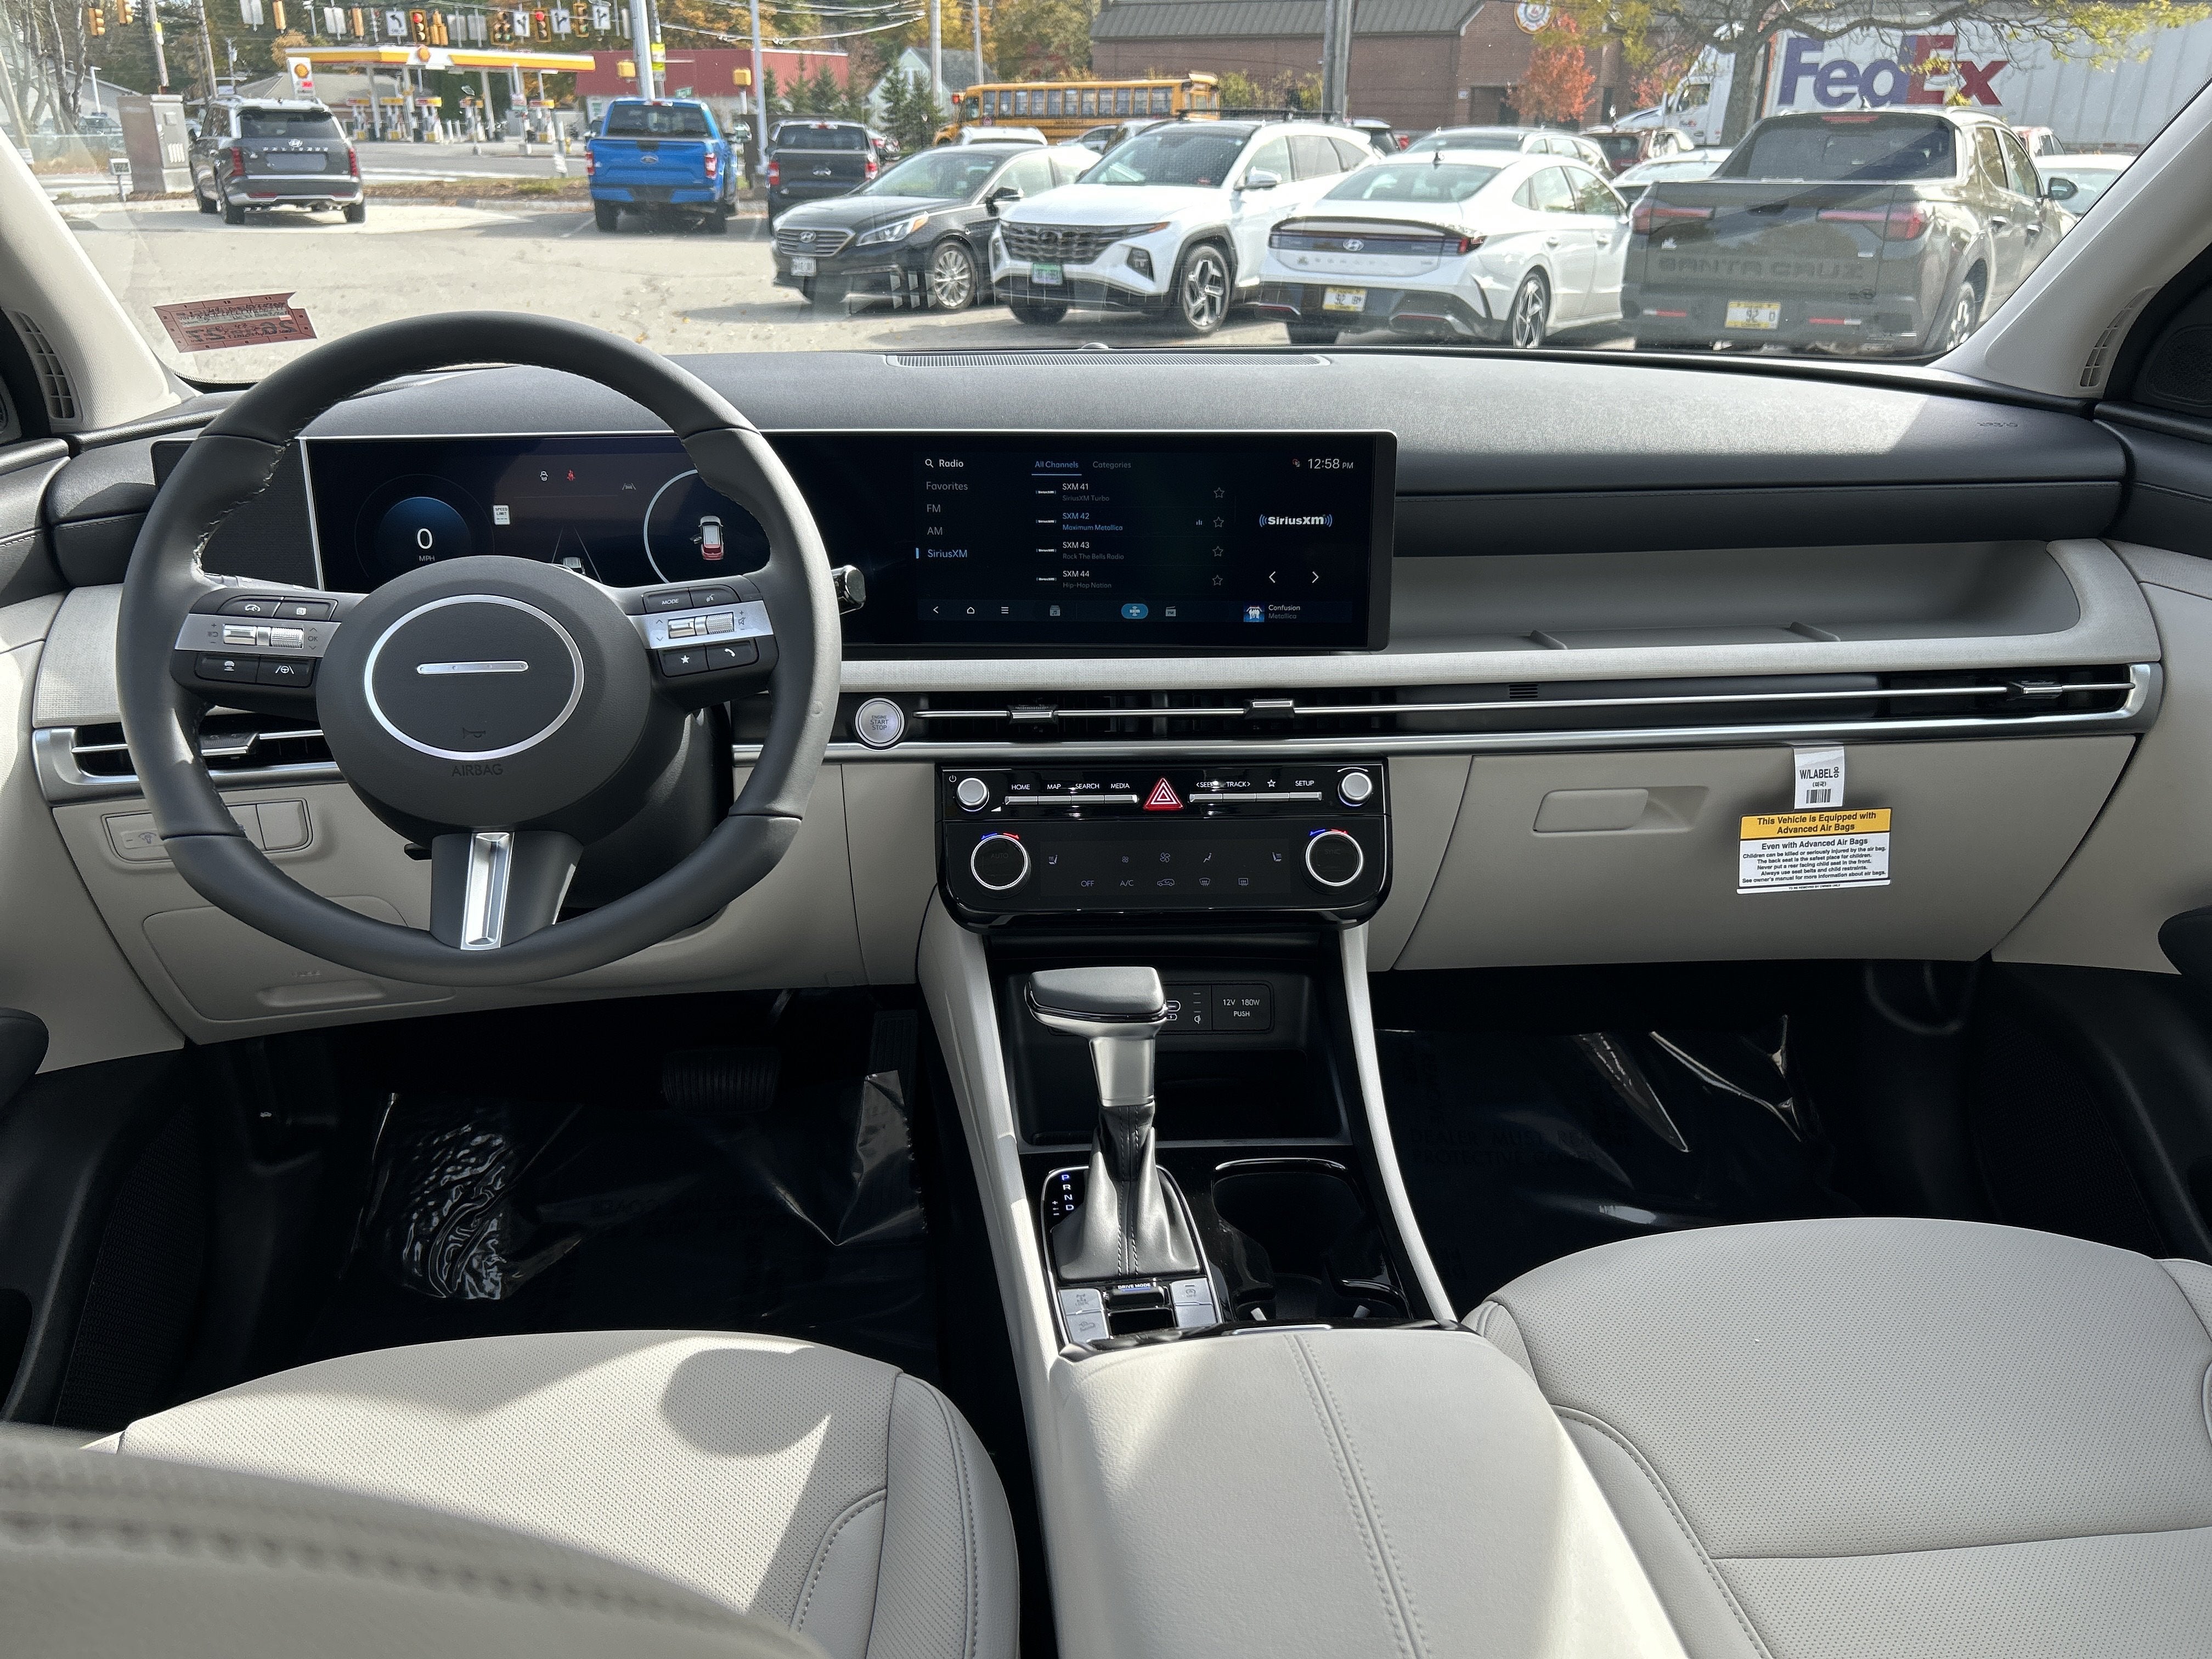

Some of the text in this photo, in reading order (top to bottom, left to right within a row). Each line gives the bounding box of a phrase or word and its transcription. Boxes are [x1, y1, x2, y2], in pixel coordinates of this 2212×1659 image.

[1778, 35, 2011, 108] FedEx
[1092, 461, 1131, 470] Categories
[1308, 459, 1340, 469] 12:58
[926, 481, 968, 490] Favorites
[927, 504, 941, 512] FM
[927, 527, 943, 535] AM
[417, 528, 432, 549] 0
[927, 549, 968, 558] SiriusXM
[452, 764, 503, 776] AIRBAG
[1778, 816, 1807, 824] Vehicle
[1819, 812, 1857, 823] Equipped
[1777, 825, 1818, 834] Advanced
[1834, 823, 1855, 832] Bags
[1799, 839, 1835, 848] Advanced
